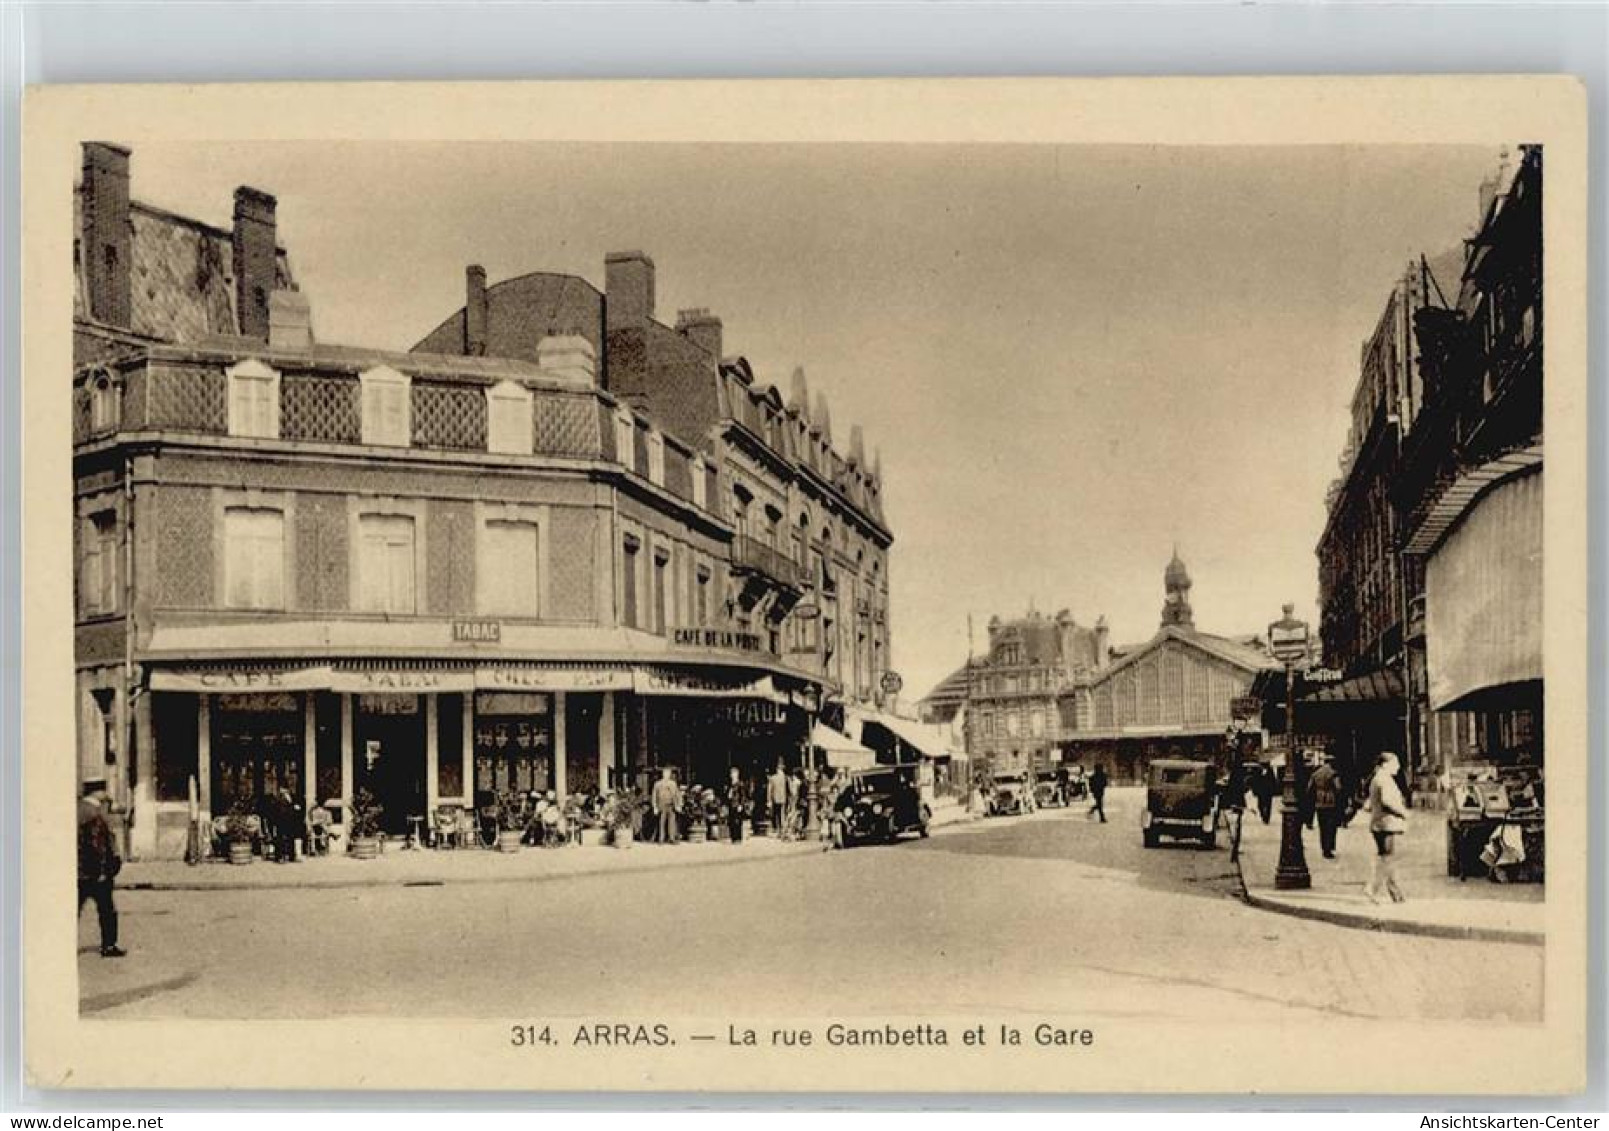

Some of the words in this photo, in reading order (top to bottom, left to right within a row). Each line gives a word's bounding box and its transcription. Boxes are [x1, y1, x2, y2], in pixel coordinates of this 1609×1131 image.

[455, 623, 498, 640] TABAC
[705, 630, 718, 648] DE
[721, 631, 733, 649] LA
[734, 702, 788, 724] PAUL
